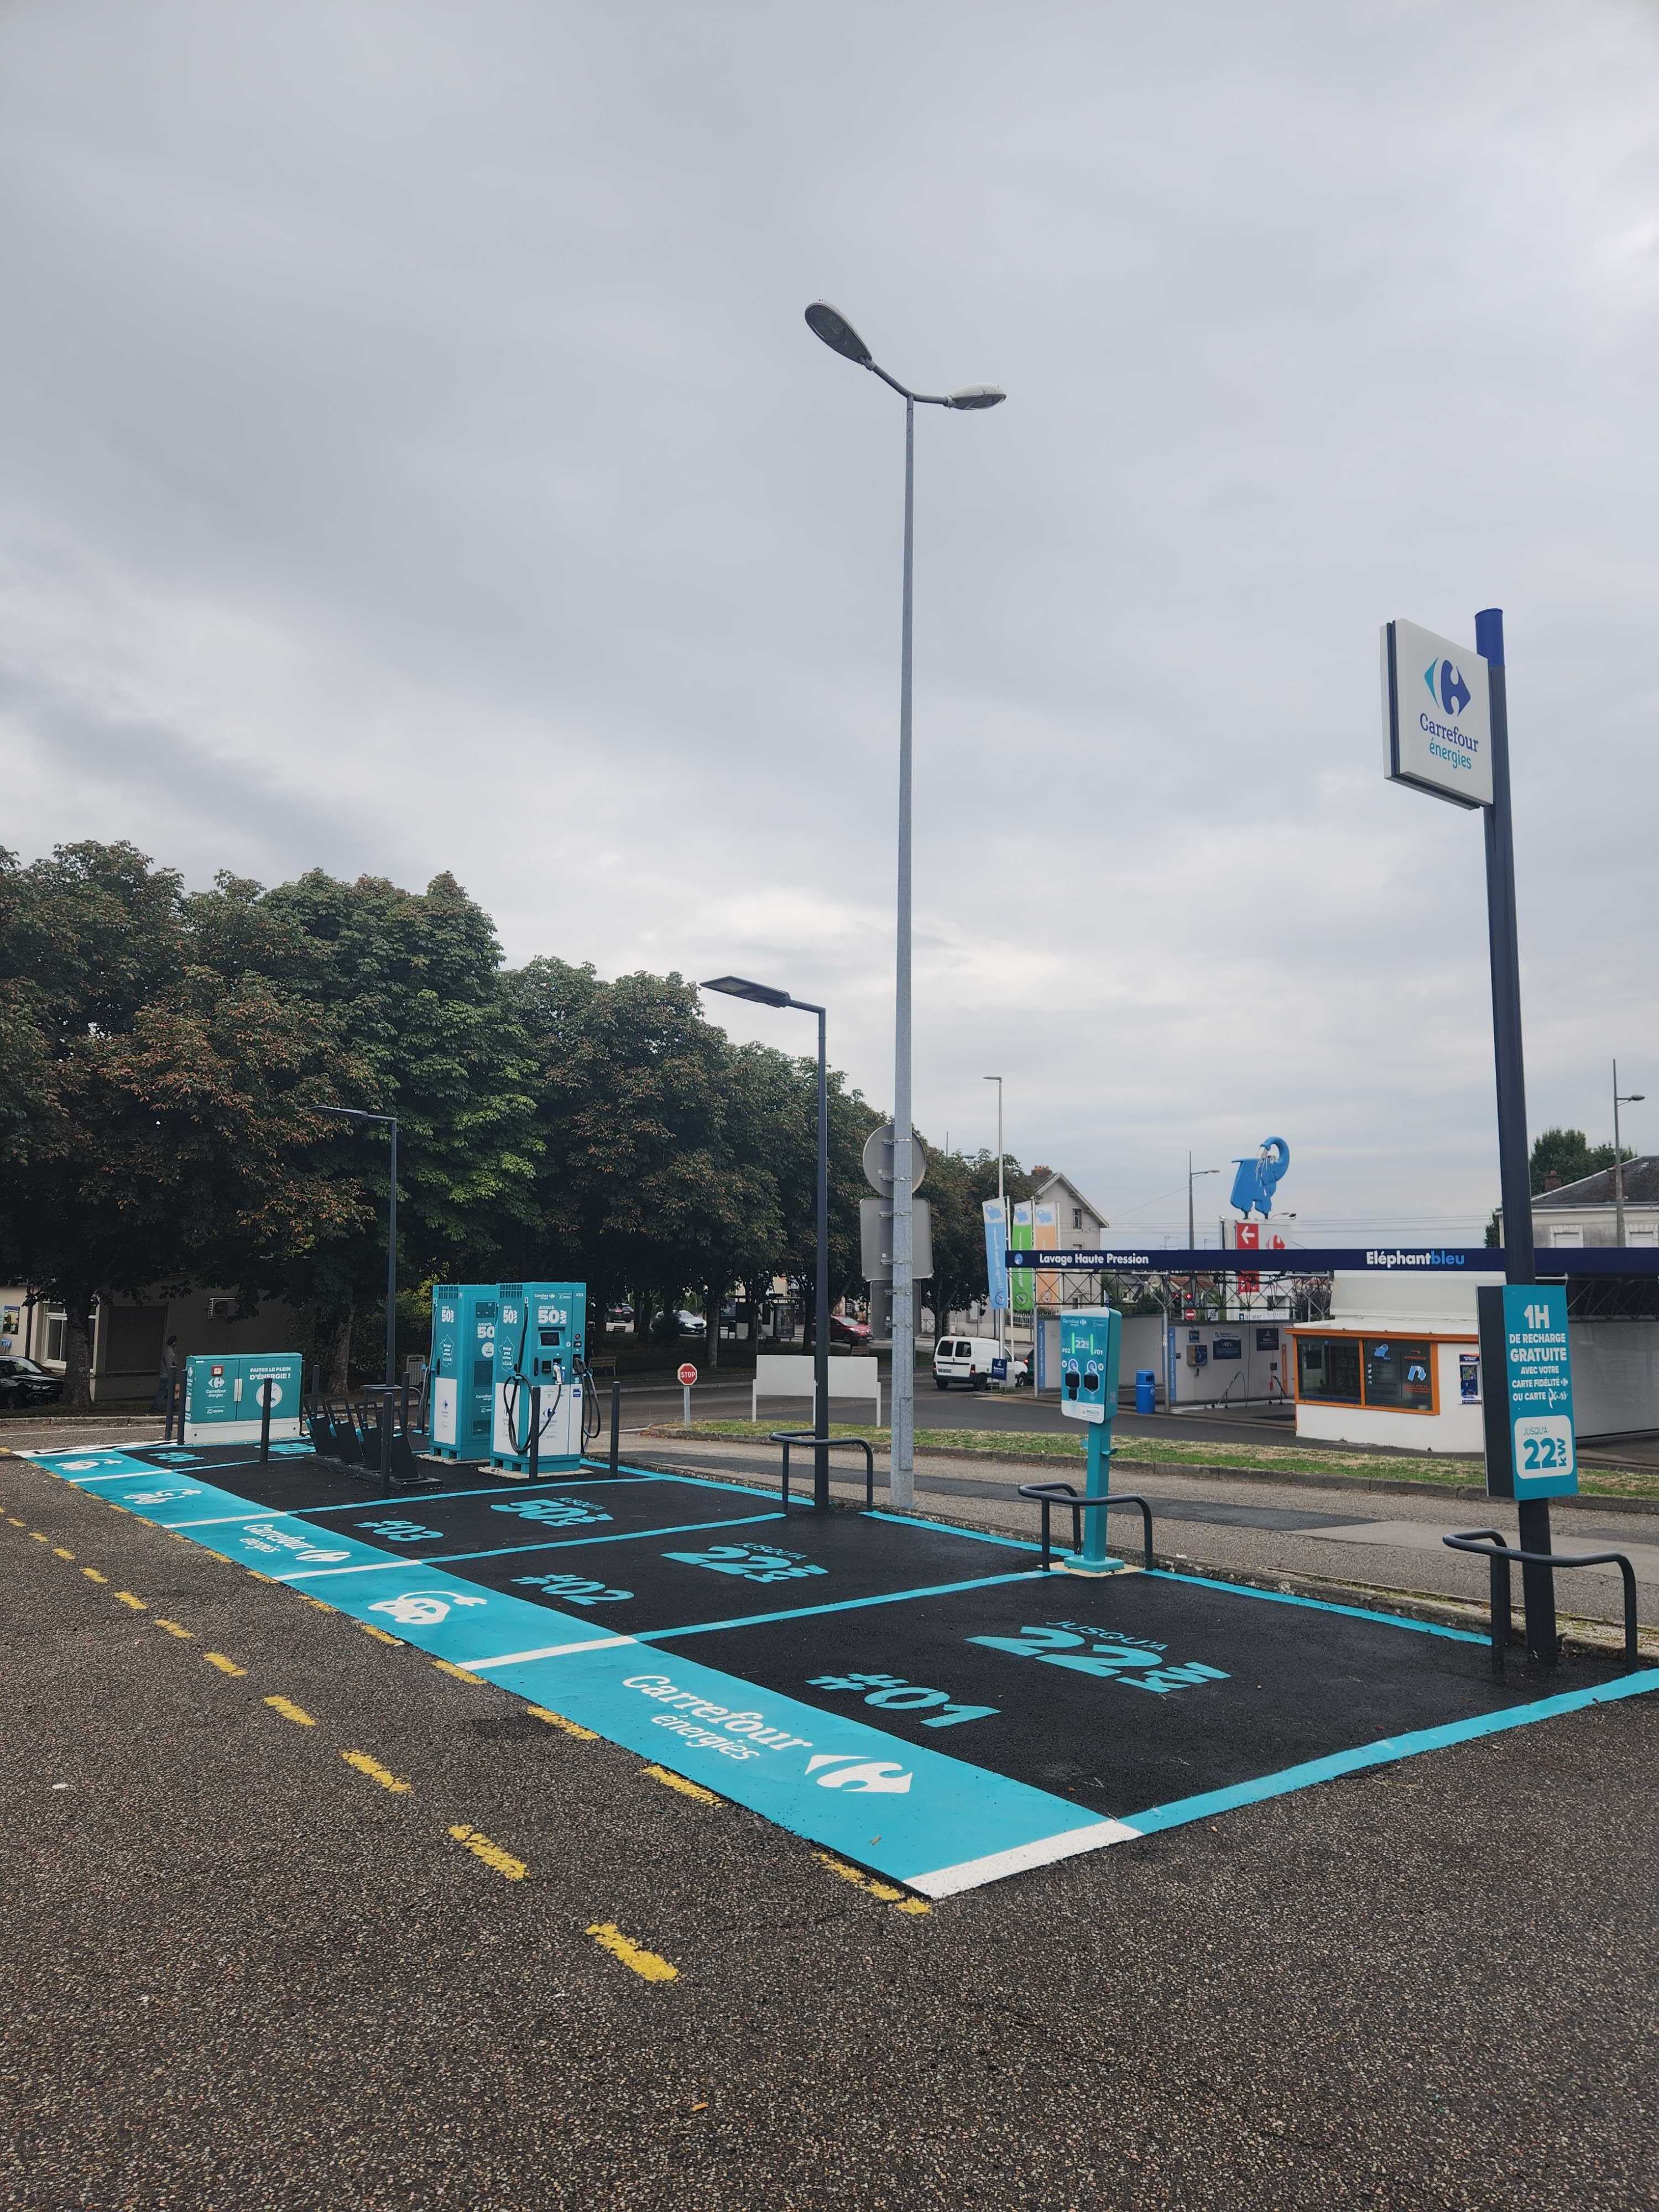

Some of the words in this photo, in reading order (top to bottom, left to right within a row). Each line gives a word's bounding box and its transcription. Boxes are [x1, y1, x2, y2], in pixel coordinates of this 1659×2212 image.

[1420, 712, 1479, 753] Carrefour
[1429, 737, 1472, 770] énergies
[1039, 1253, 1072, 1265] Lavage
[1074, 1253, 1104, 1264] Haute
[1107, 1253, 1149, 1264] Pression
[1366, 1250, 1464, 1268] Eléphantbleu
[441, 1310, 451, 1322] 50
[503, 1310, 514, 1323] 50
[538, 1310, 560, 1324] 50
[1524, 1305, 1550, 1329] 1H
[477, 1326, 495, 1339] 50
[1509, 1333, 1521, 1344] DE
[1522, 1333, 1566, 1344] RECHARGE
[1510, 1347, 1567, 1363] GRATUITE
[1520, 1366, 1538, 1375] AVEC
[1538, 1365, 1559, 1374] VOTRE
[1512, 1379, 1533, 1389] CARTE
[1533, 1376, 1561, 1387] FIDÉLITÉ
[1512, 1392, 1524, 1401] OU
[1524, 1391, 1546, 1401] CARTE
[1523, 1437, 1557, 1470] 22
[490, 1499, 588, 1520] 50
[242, 1524, 316, 1550] Carrefour
[659, 1546, 792, 1575] 22
[509, 1574, 635, 1606] #02
[964, 1626, 1163, 1677] 22
[805, 1673, 1002, 1728] #01
[622, 1675, 813, 1751] Carrefour
[650, 1715, 760, 1760] énergies
